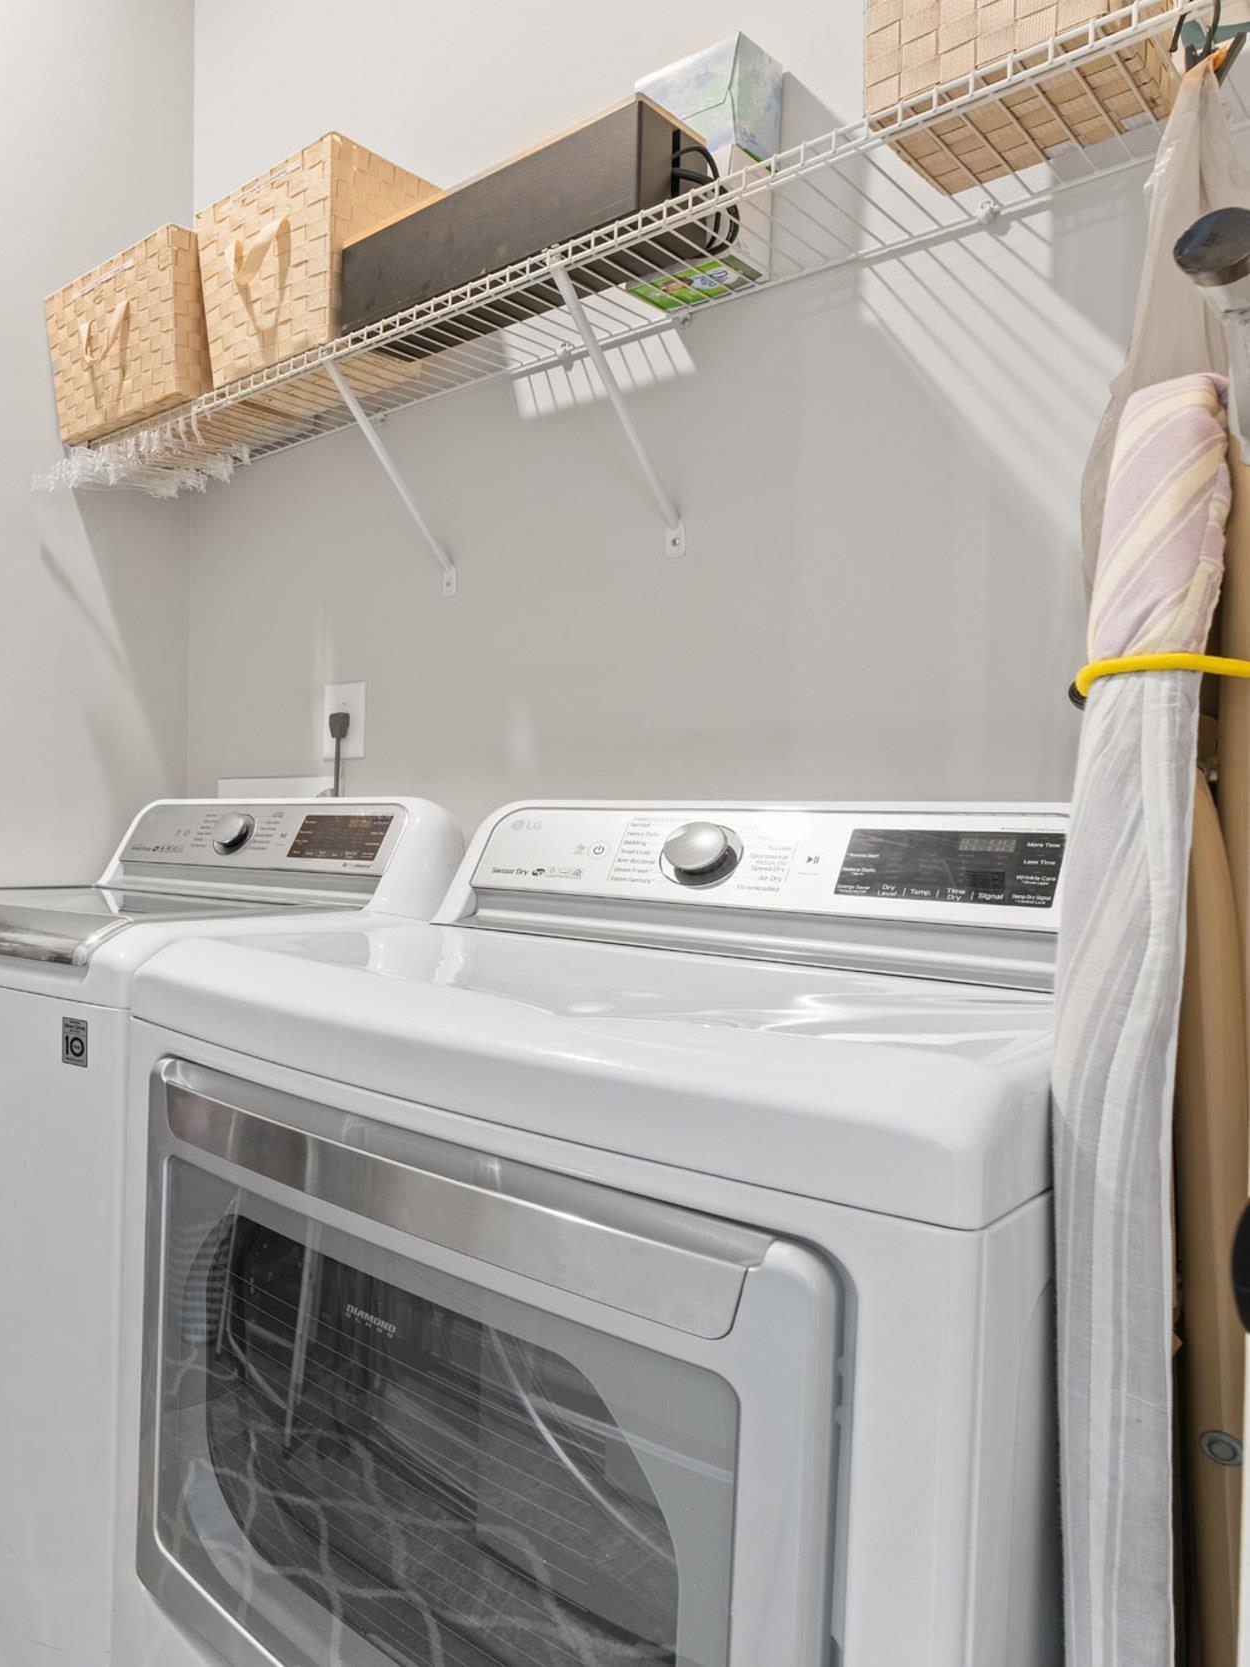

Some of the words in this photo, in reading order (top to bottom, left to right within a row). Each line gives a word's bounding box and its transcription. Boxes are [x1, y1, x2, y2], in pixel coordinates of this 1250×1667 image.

[525, 821, 542, 830] LG
[946, 887, 967, 895] Time
[946, 894, 963, 902] Dry
[977, 892, 1005, 901] Signal
[346, 1303, 397, 1334] DIAMOND
